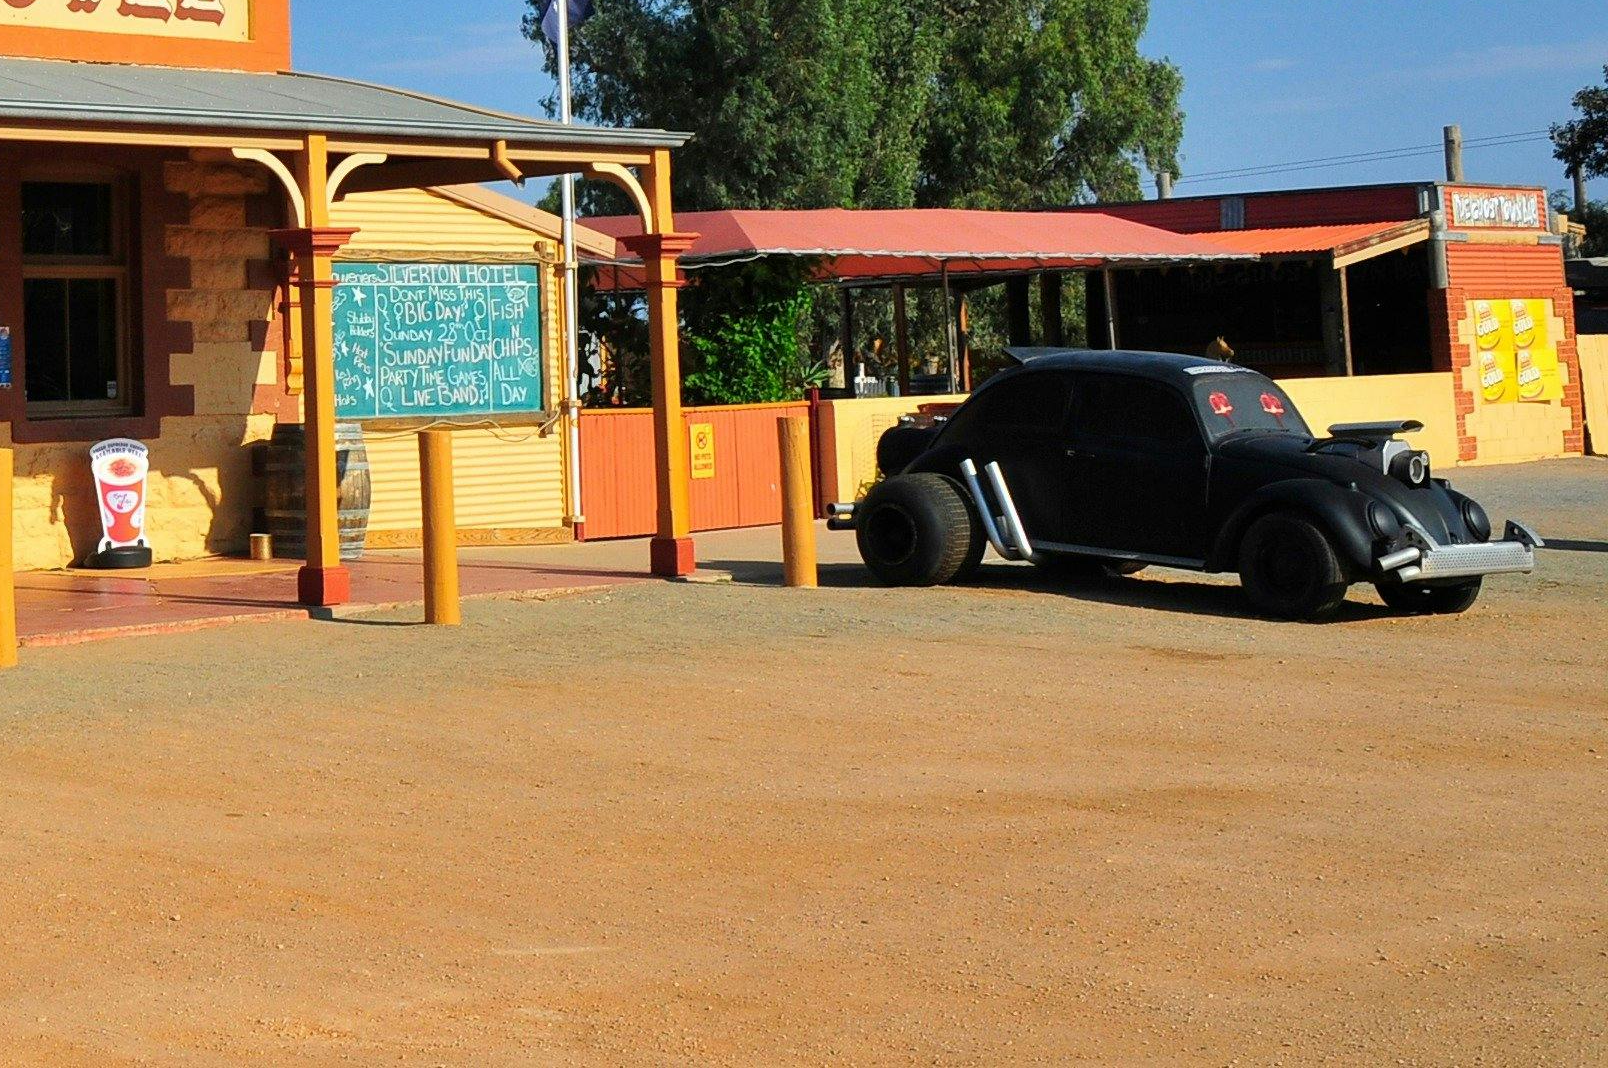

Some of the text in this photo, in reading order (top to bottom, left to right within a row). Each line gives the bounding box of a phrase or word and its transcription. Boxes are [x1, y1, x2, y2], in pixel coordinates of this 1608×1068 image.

[377, 264, 526, 282] SILVERTON HOTEL
[428, 285, 457, 301] MISS
[458, 285, 485, 301] THIS
[404, 301, 433, 325] BIG
[490, 298, 524, 321] FISH
[383, 321, 433, 342] SUNDAY
[383, 342, 443, 366] SUNDAY
[380, 364, 487, 388] PARTY TIME GAMES
[493, 361, 520, 381] ALL
[401, 386, 435, 407] LIVE
[501, 382, 528, 405] DAY
